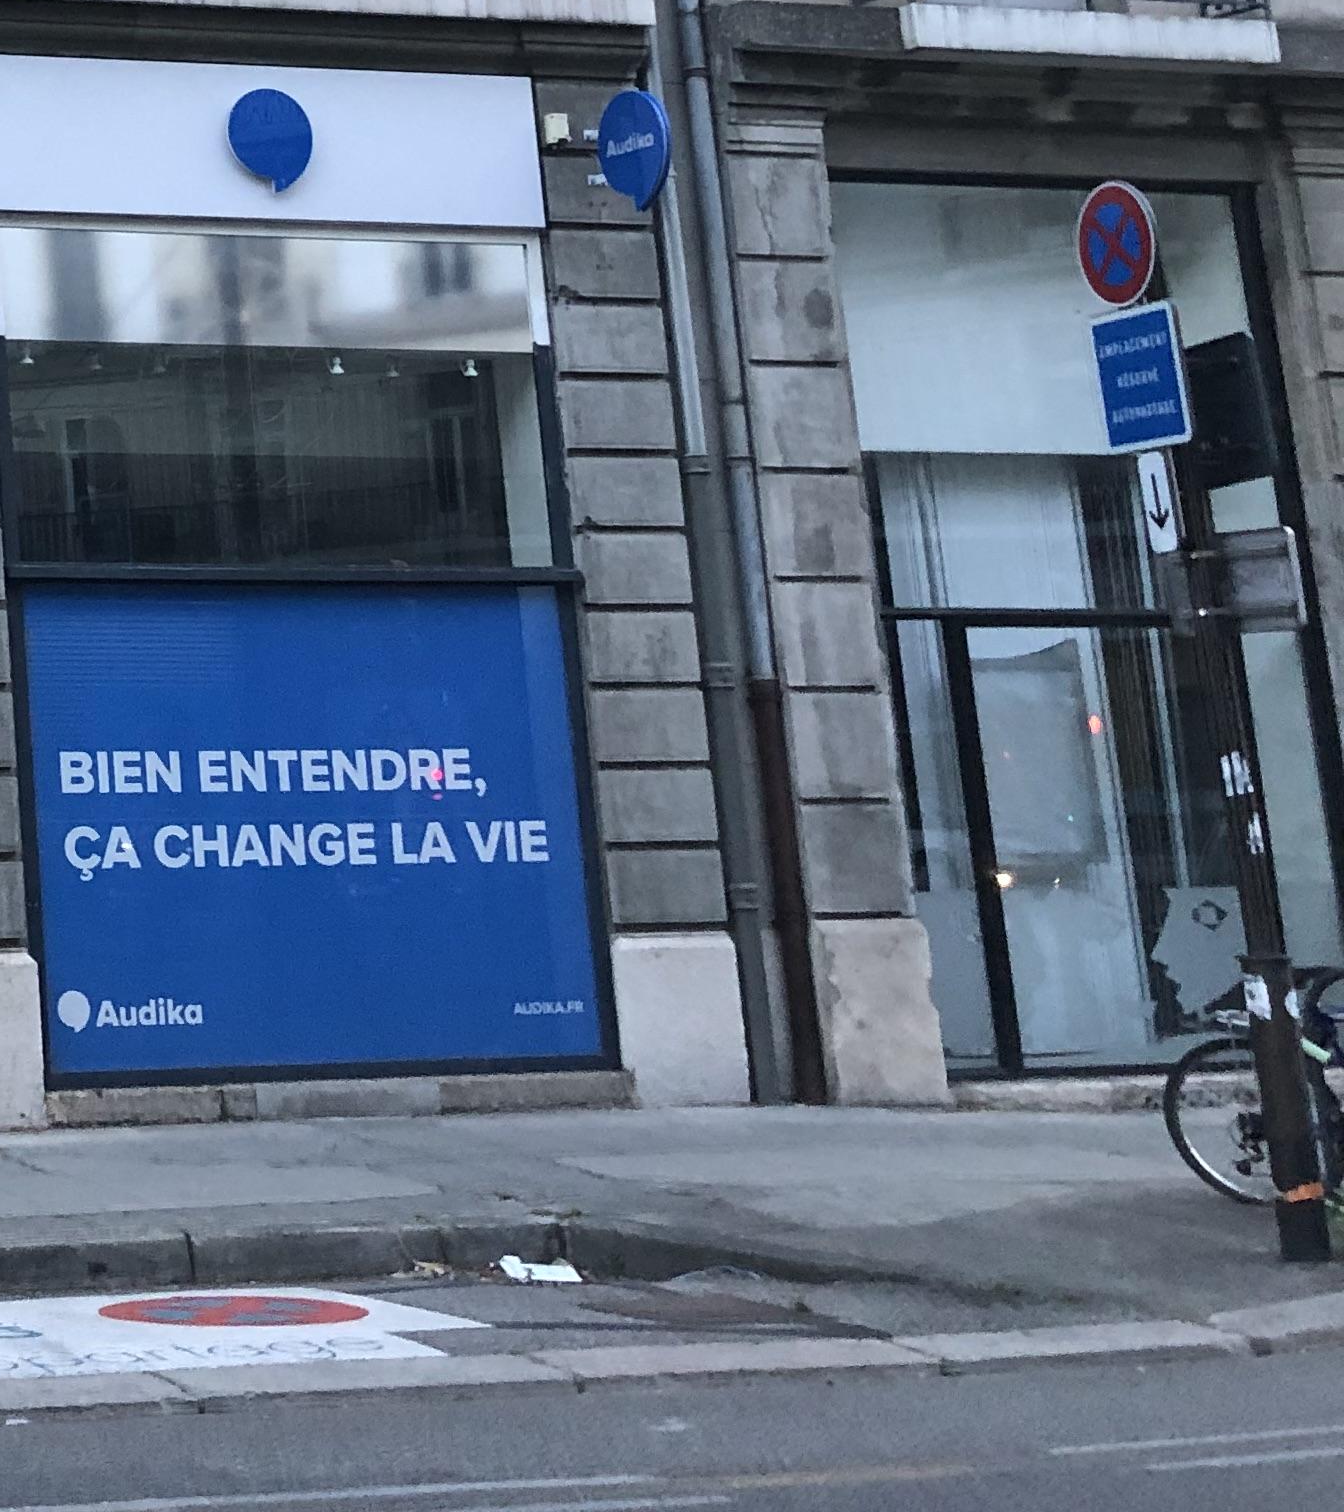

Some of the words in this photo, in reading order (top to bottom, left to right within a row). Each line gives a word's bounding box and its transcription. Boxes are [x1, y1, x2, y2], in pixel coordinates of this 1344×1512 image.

[605, 131, 655, 159] Audika
[59, 750, 181, 793] BIEN
[198, 748, 488, 797] ENTENDRE,
[63, 824, 141, 881] ÇA
[153, 821, 378, 868] CHANGE
[392, 821, 457, 864] LA
[465, 819, 551, 863] VIE
[95, 997, 204, 1028] Audika
